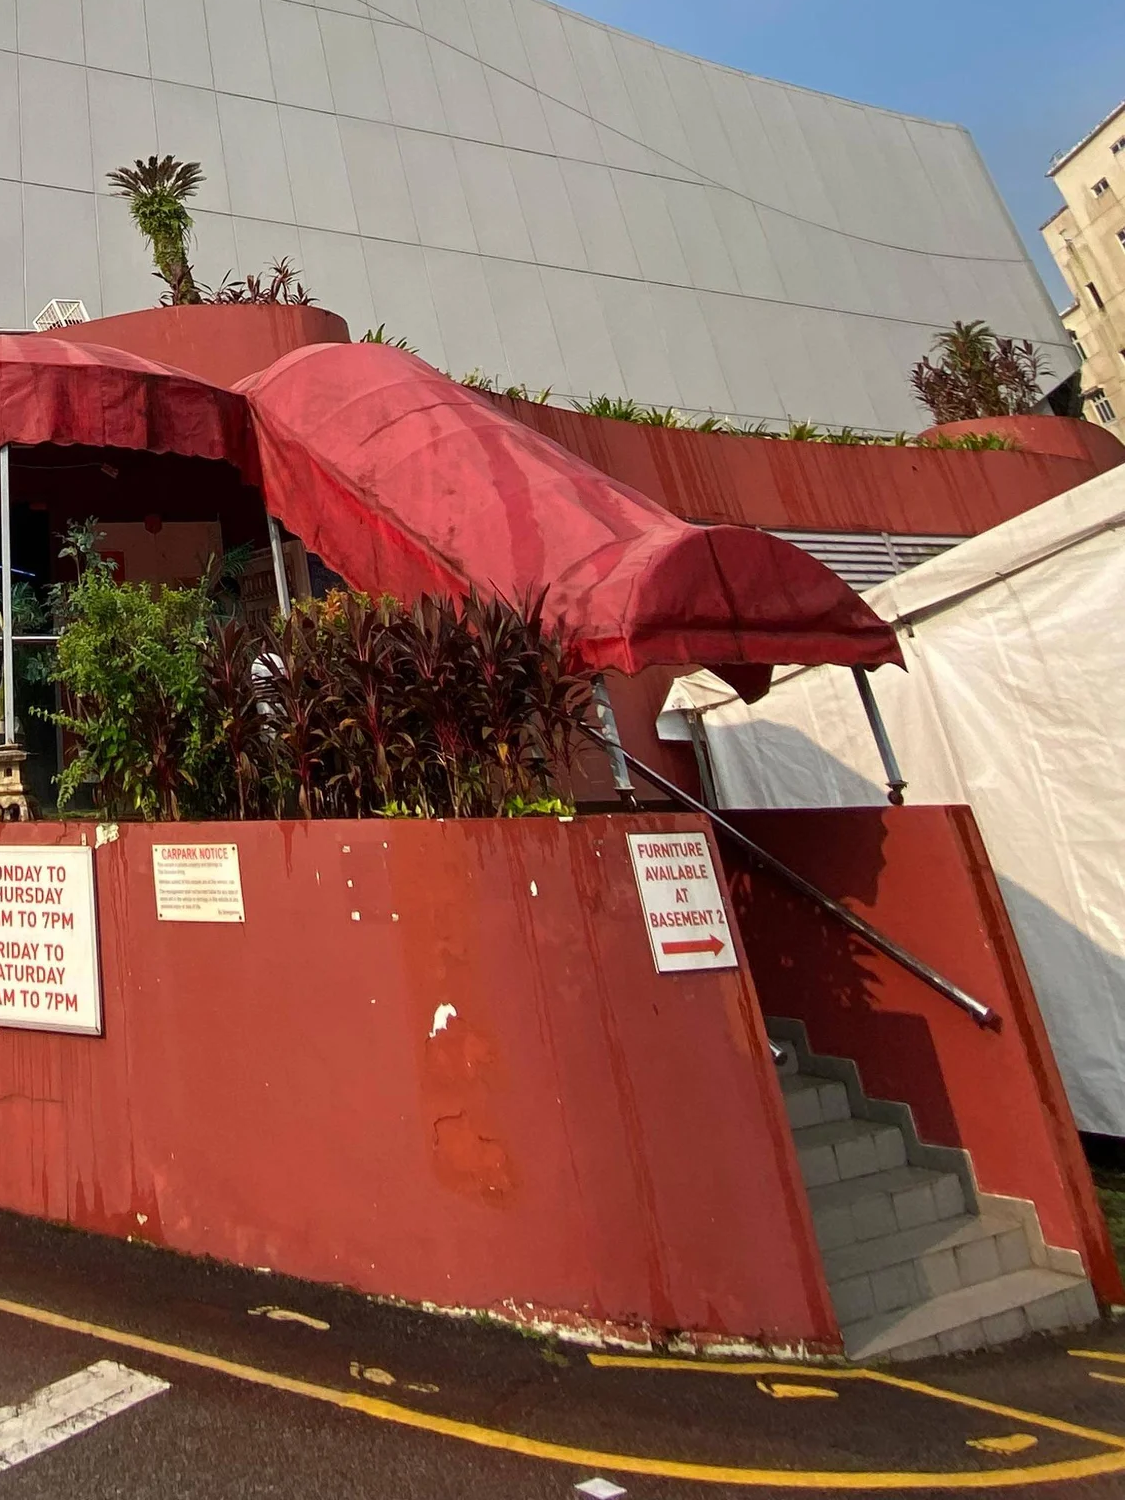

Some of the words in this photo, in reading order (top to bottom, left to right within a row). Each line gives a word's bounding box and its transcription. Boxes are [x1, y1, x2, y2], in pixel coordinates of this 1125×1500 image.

[161, 847, 197, 860] CARPARK
[199, 847, 228, 860] NOTICE
[637, 842, 704, 858] FURNITURE
[47, 866, 66, 882] TO
[645, 864, 709, 881] AVAILABLE
[675, 888, 689, 903] AT
[18, 911, 37, 928] TO
[42, 911, 74, 930] 7PM
[649, 909, 714, 928] BASEMENT
[717, 910, 725, 924] 2
[44, 943, 64, 961] TO
[20, 990, 39, 1008] TO
[45, 991, 78, 1012] 7PM
